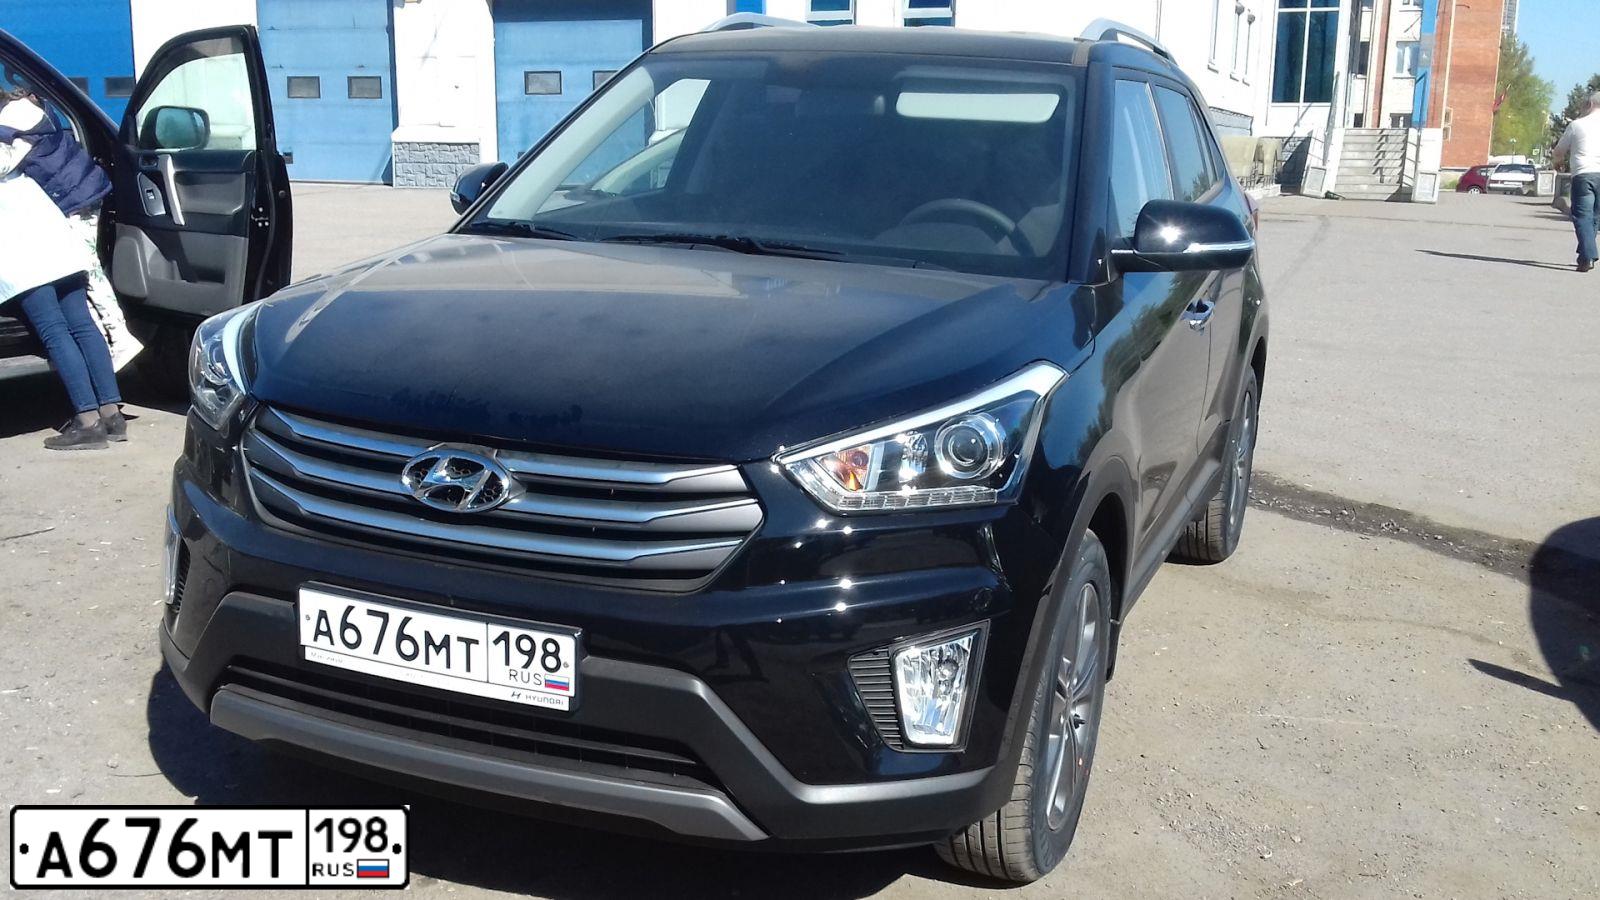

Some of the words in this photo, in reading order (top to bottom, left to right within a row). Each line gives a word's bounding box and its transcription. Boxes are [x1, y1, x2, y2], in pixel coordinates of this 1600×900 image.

[492, 630, 562, 673] 198
[508, 668, 543, 686] RUS
[525, 694, 564, 706] HYUNDAI
